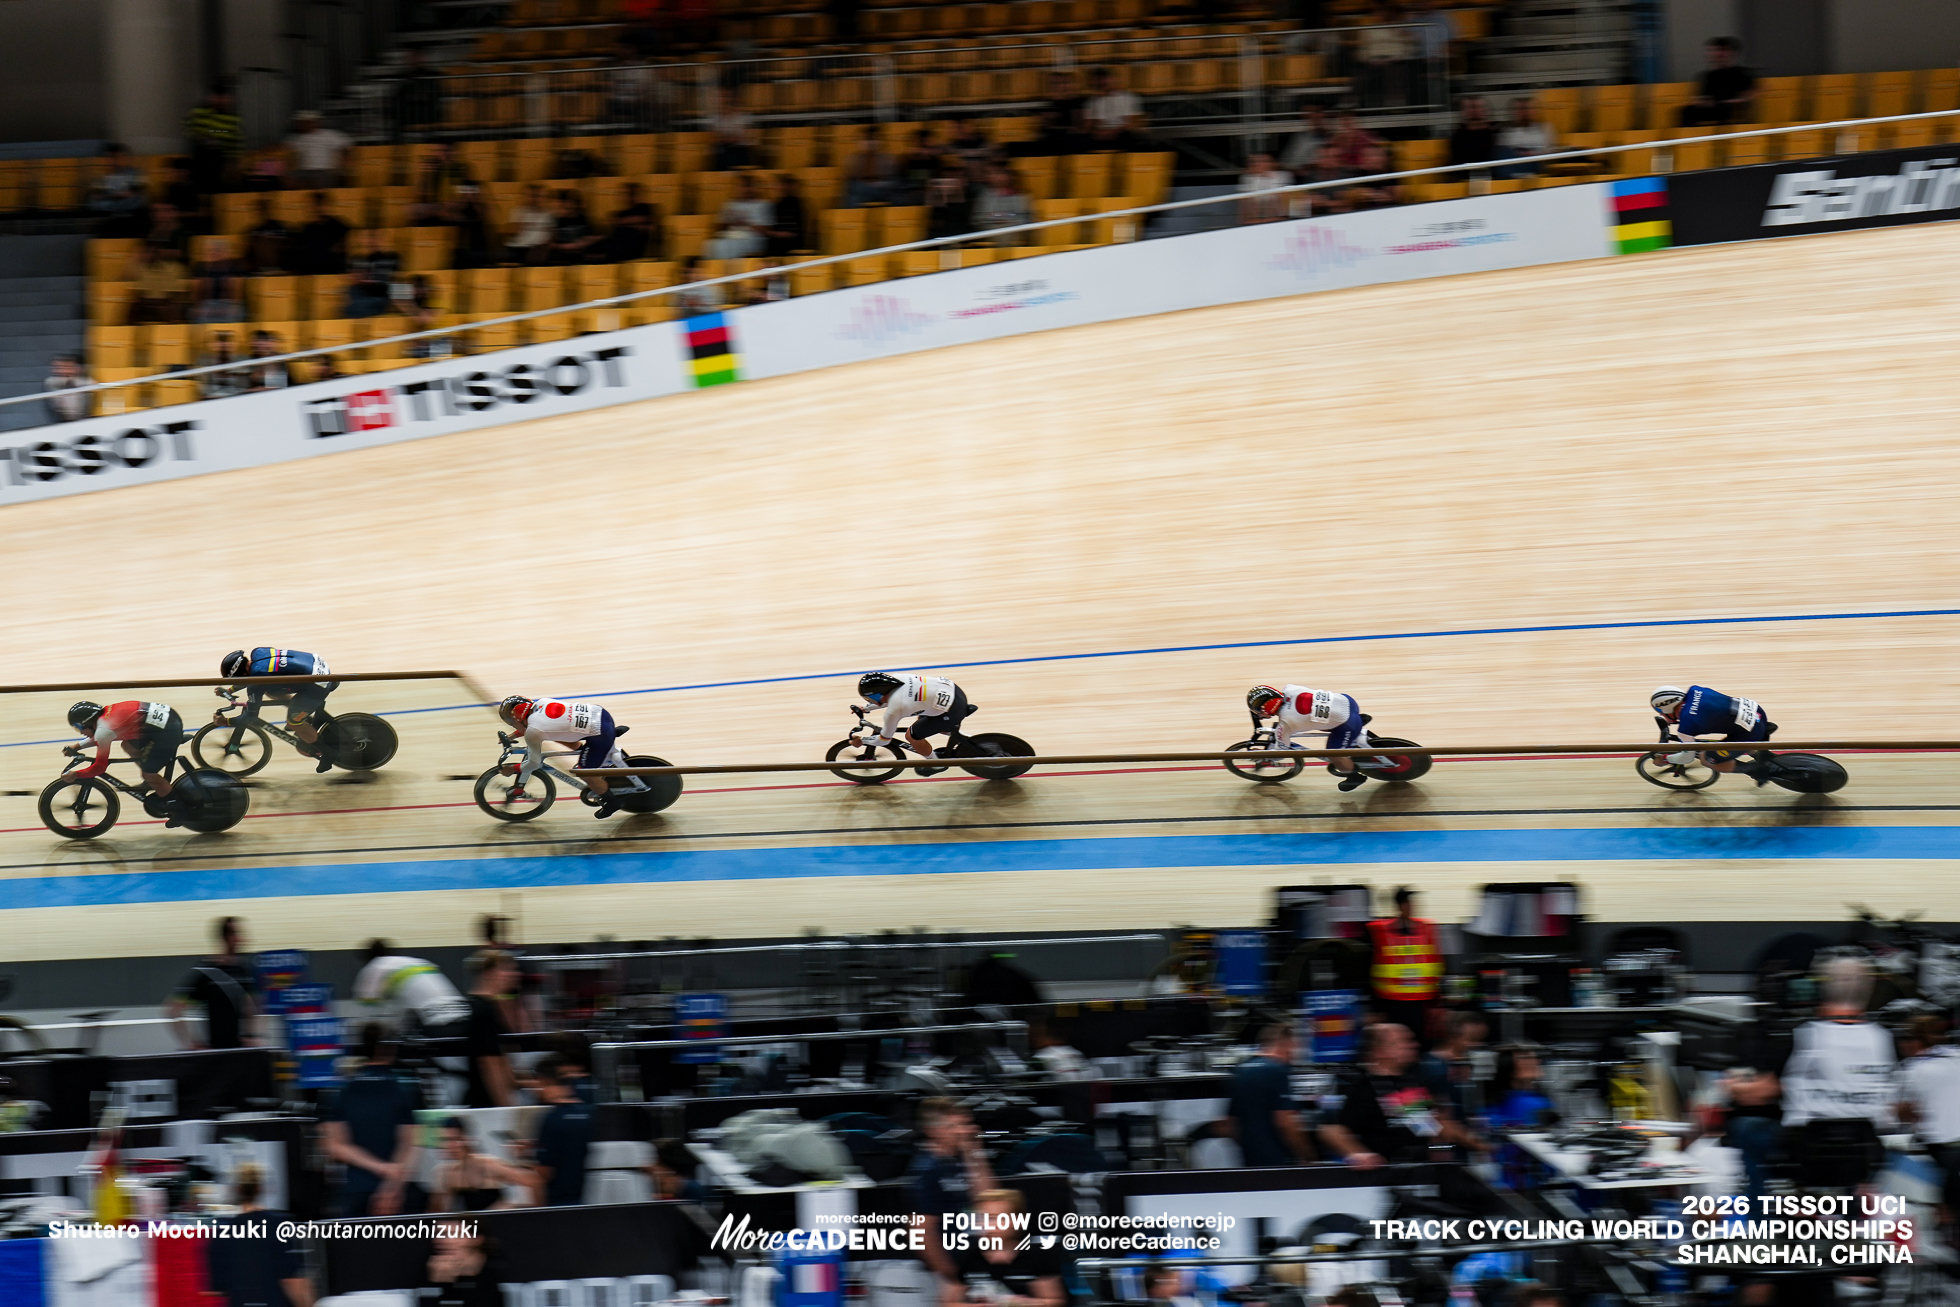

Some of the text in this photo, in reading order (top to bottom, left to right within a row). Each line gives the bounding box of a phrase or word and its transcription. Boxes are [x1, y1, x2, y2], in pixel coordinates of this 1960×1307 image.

[394, 346, 637, 422] TISSOT
[0, 419, 206, 487] ISSOT
[1314, 704, 1330, 719] 168
[1689, 689, 1704, 715] FRANCE
[574, 715, 589, 729] 167
